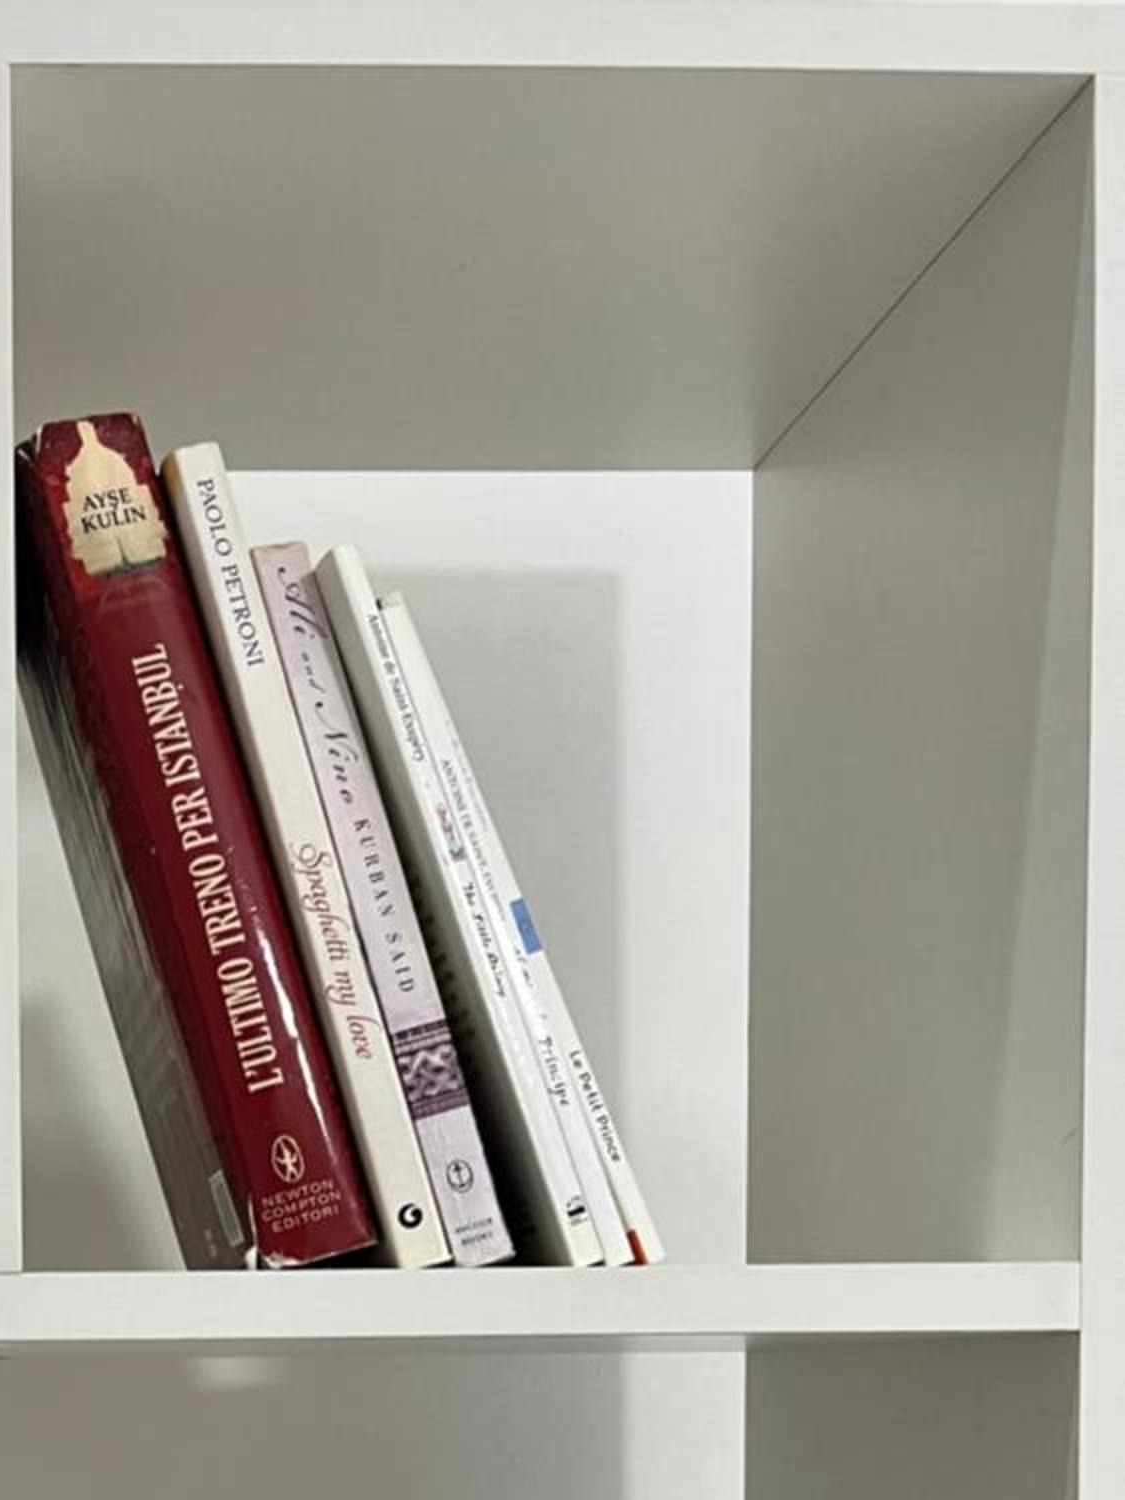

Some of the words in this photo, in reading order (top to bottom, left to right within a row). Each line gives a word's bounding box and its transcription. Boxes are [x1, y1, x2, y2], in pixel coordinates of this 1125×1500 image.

[83, 488, 132, 513] AYŞE
[196, 478, 233, 557] PAOLO
[220, 563, 266, 668] PETRONI
[277, 566, 328, 640] Ali
[132, 643, 202, 787] ISTANBUL
[300, 650, 326, 694] and
[314, 701, 360, 805] Nino
[171, 787, 218, 852] PER
[188, 853, 246, 956] TRENO
[292, 843, 351, 962] Spaghetti
[325, 968, 357, 1010] my
[345, 1014, 381, 1060] love
[352, 817, 396, 918] KURBAN
[385, 932, 416, 995] SAID
[217, 957, 284, 1094] L'ULTIMO
[569, 1050, 582, 1068] Le
[578, 1071, 602, 1114] Petit
[595, 1115, 621, 1163] Prince
[262, 1179, 335, 1206] NEWTON
[262, 1191, 342, 1221] COMPTON
[272, 1205, 340, 1233] EDITORI
